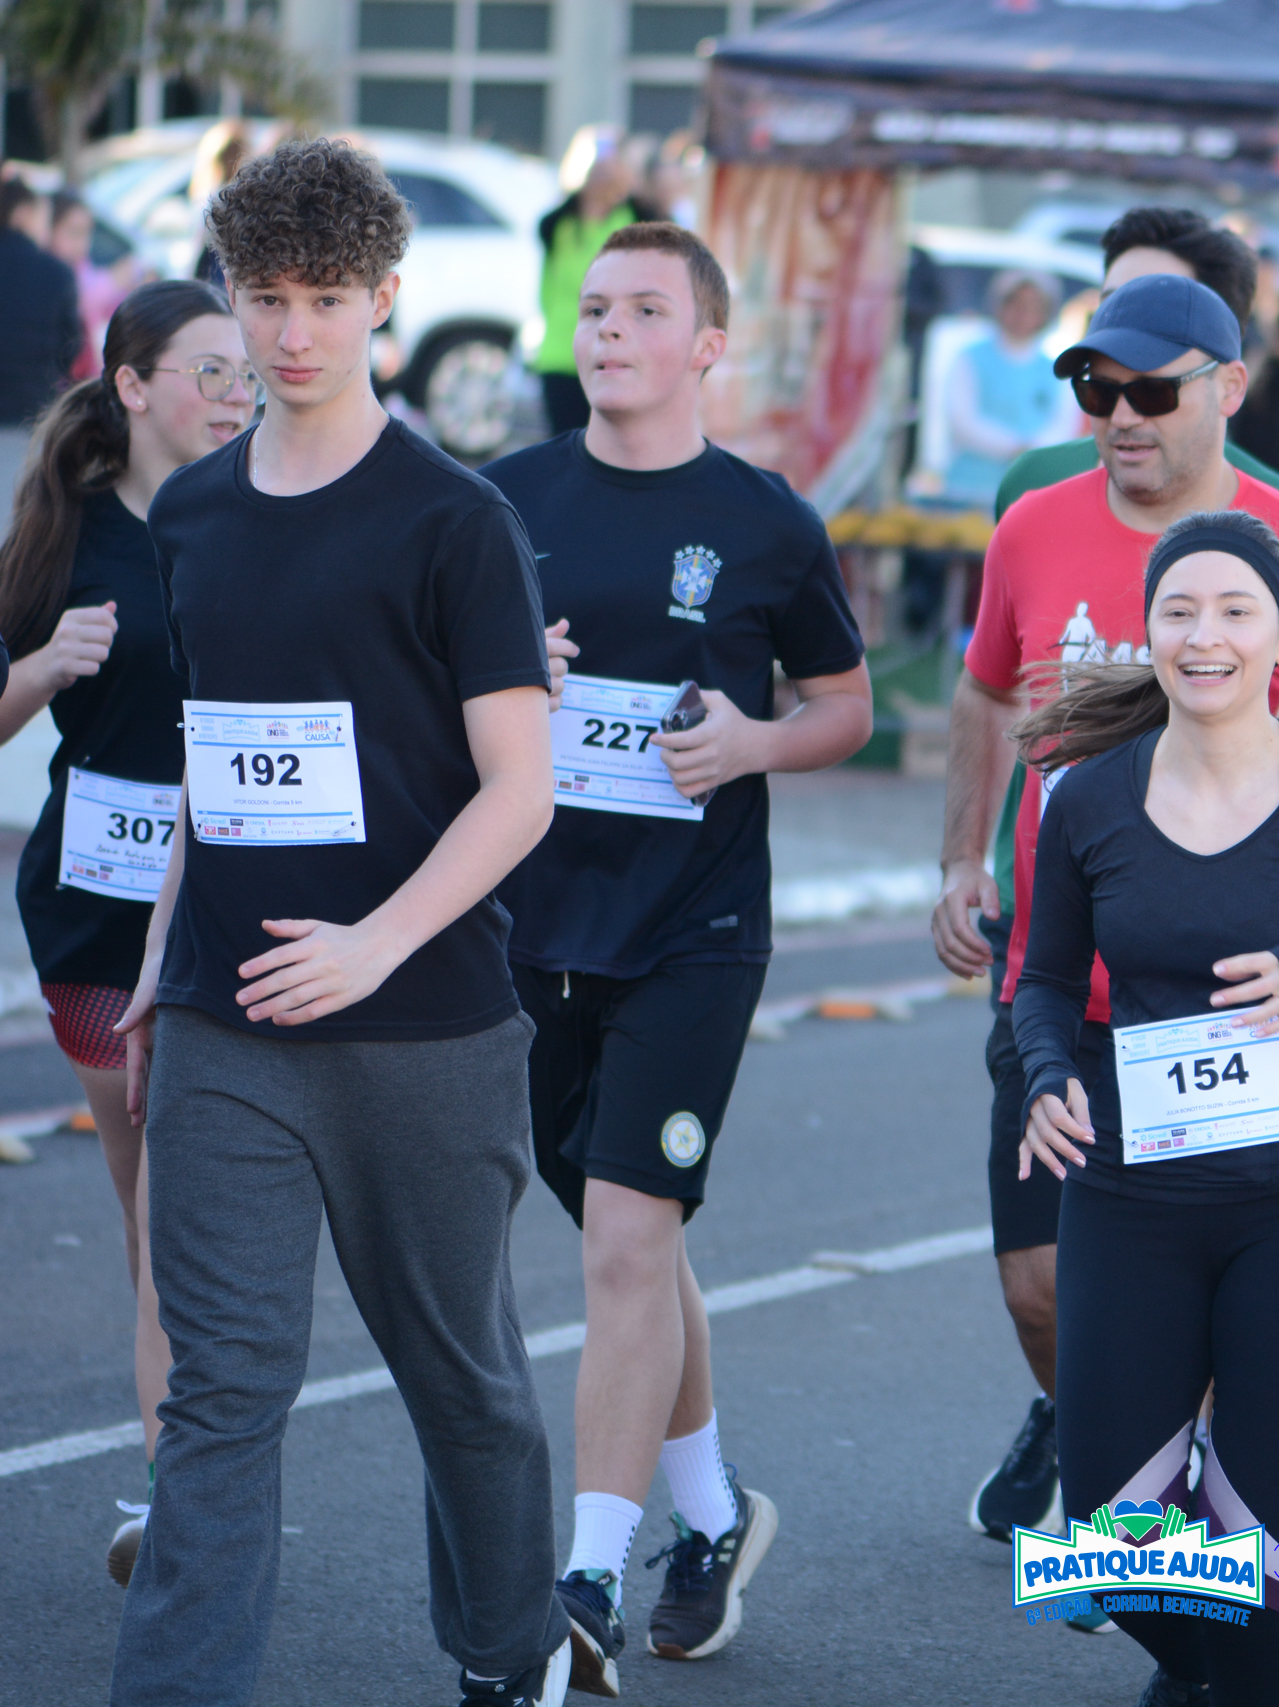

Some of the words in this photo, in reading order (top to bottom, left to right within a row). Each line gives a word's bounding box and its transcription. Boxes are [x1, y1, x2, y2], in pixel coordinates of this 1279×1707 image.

[305, 733, 331, 742] CAUSA
[581, 718, 659, 753] 227
[230, 752, 302, 786] 192
[107, 812, 176, 847] 307
[1167, 1052, 1250, 1095] 154
[1227, 1099, 1246, 1108] Corrida
